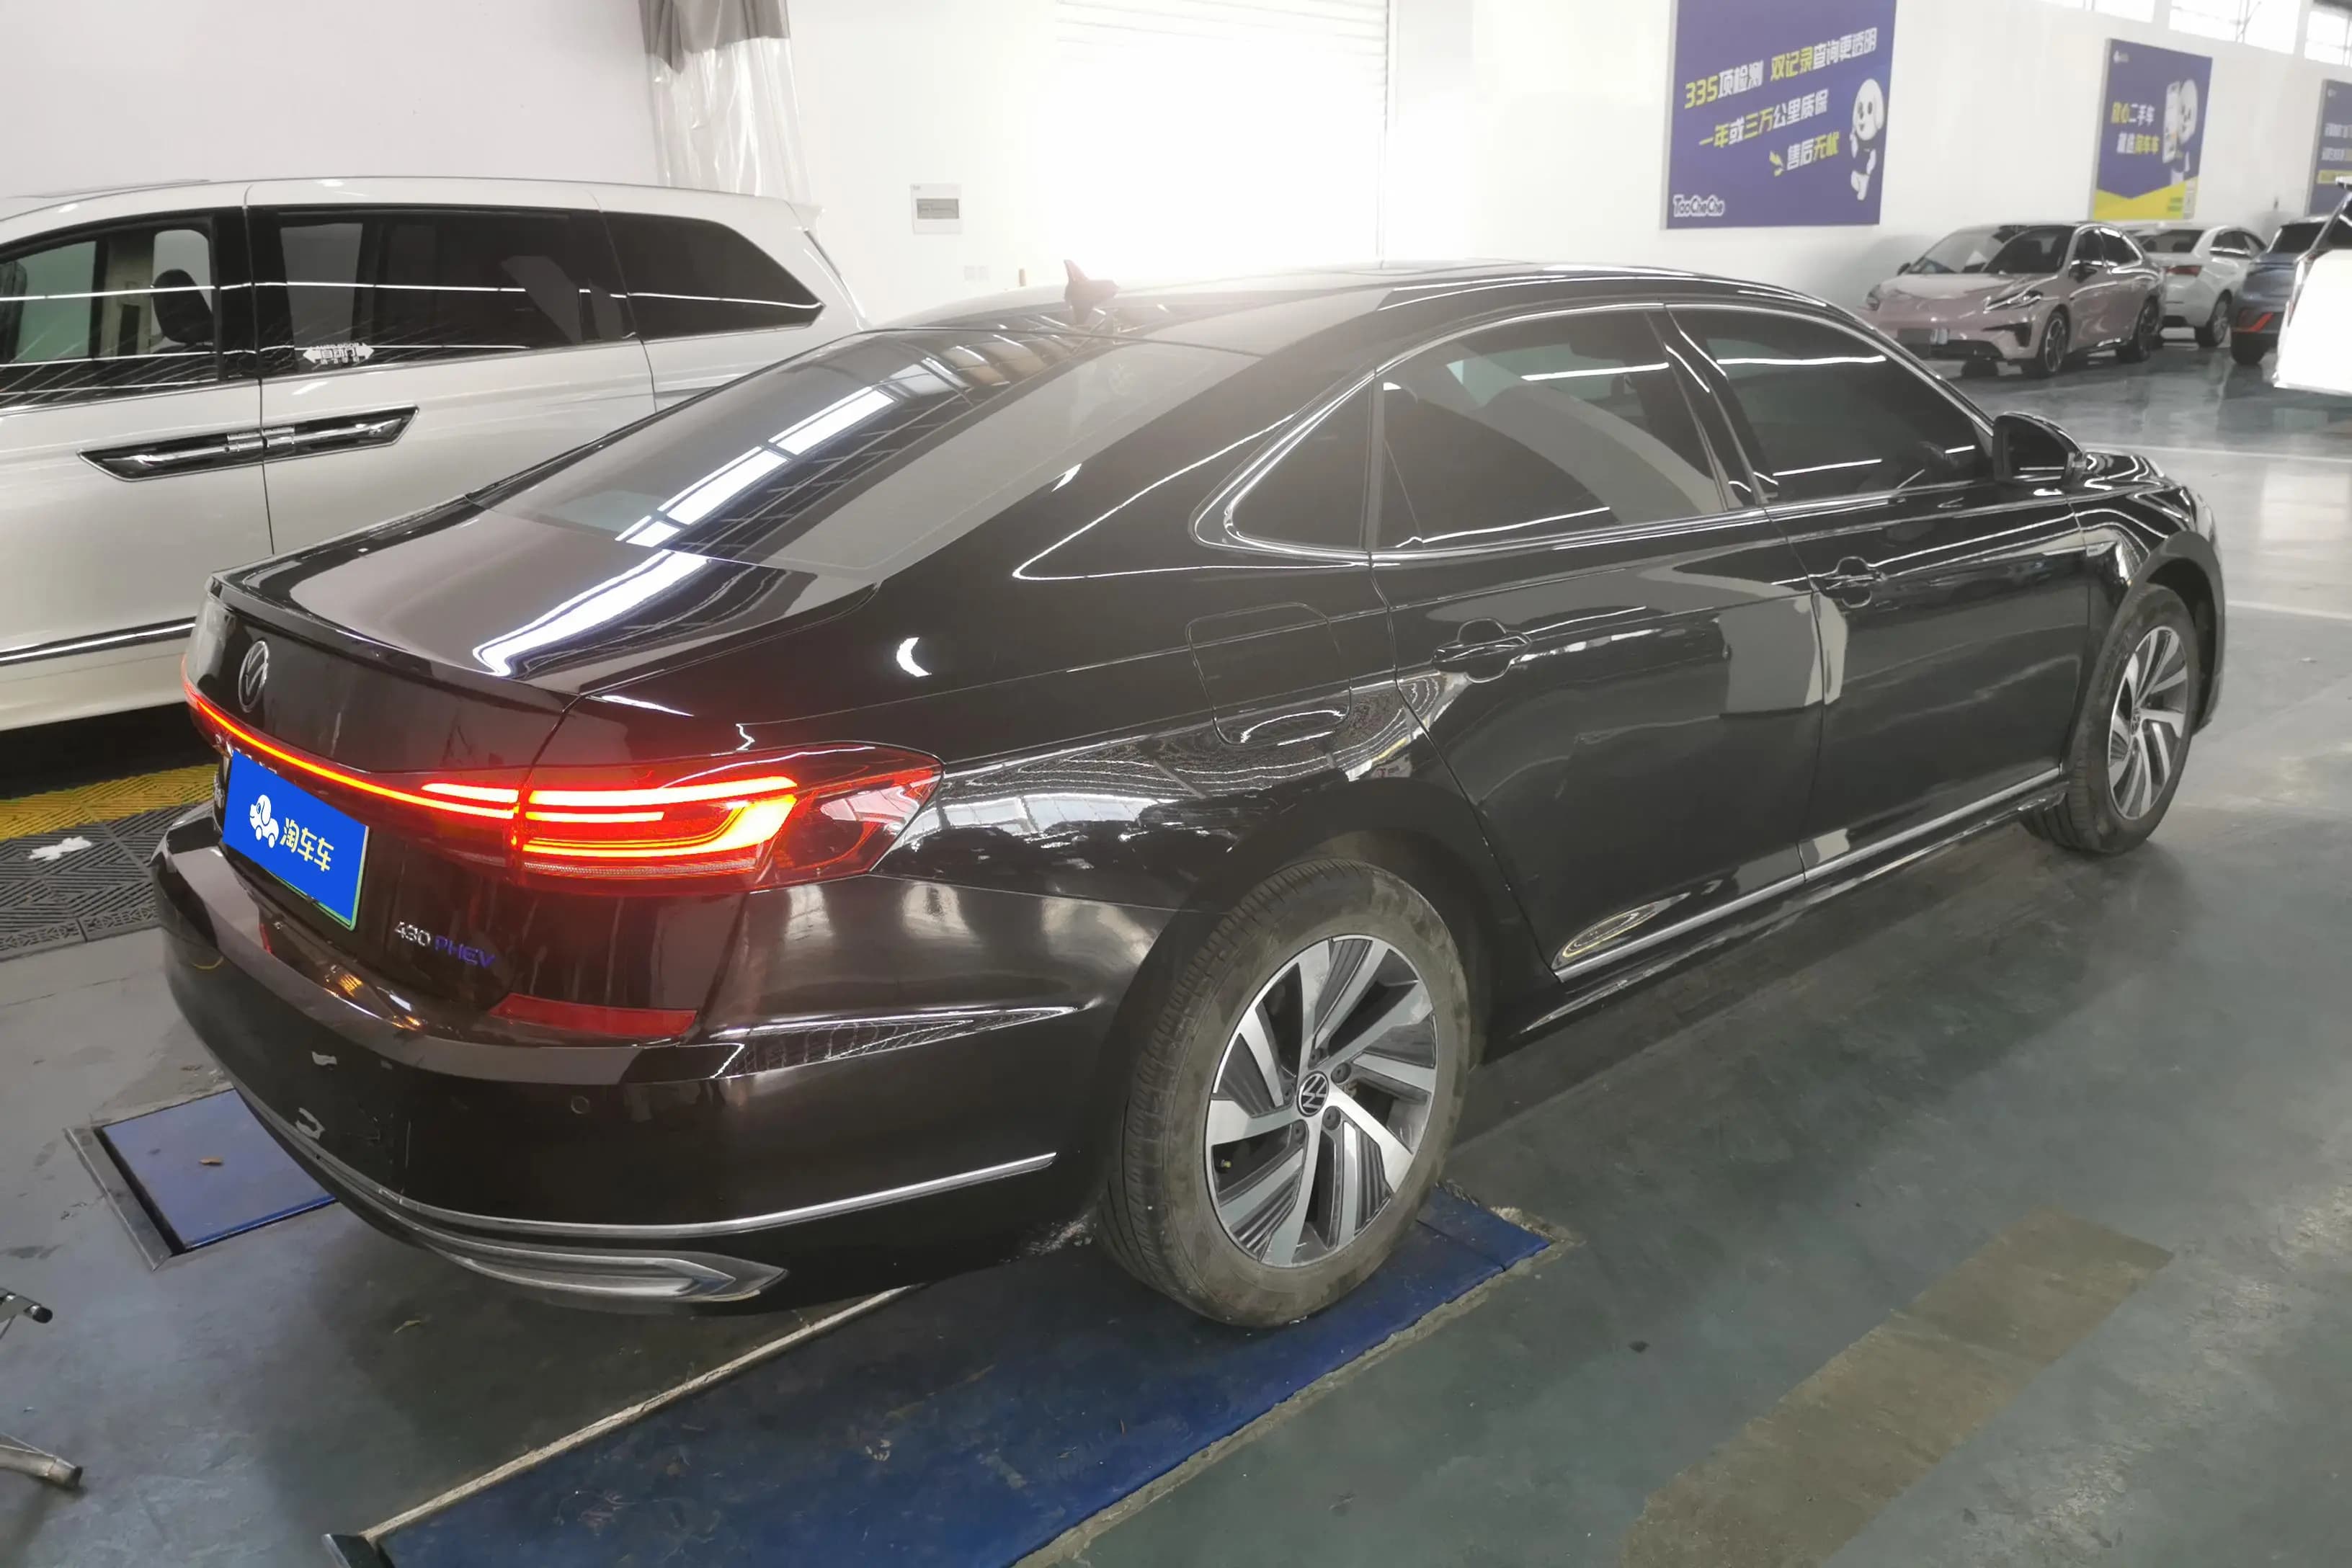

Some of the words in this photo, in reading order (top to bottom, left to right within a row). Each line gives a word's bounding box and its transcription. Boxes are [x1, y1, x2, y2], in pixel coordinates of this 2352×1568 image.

[1684, 60, 1764, 109] 335项检测
[1699, 89, 1828, 148] 一年或三万公里质保
[394, 921, 431, 946] 430
[435, 935, 495, 967] PHEV
